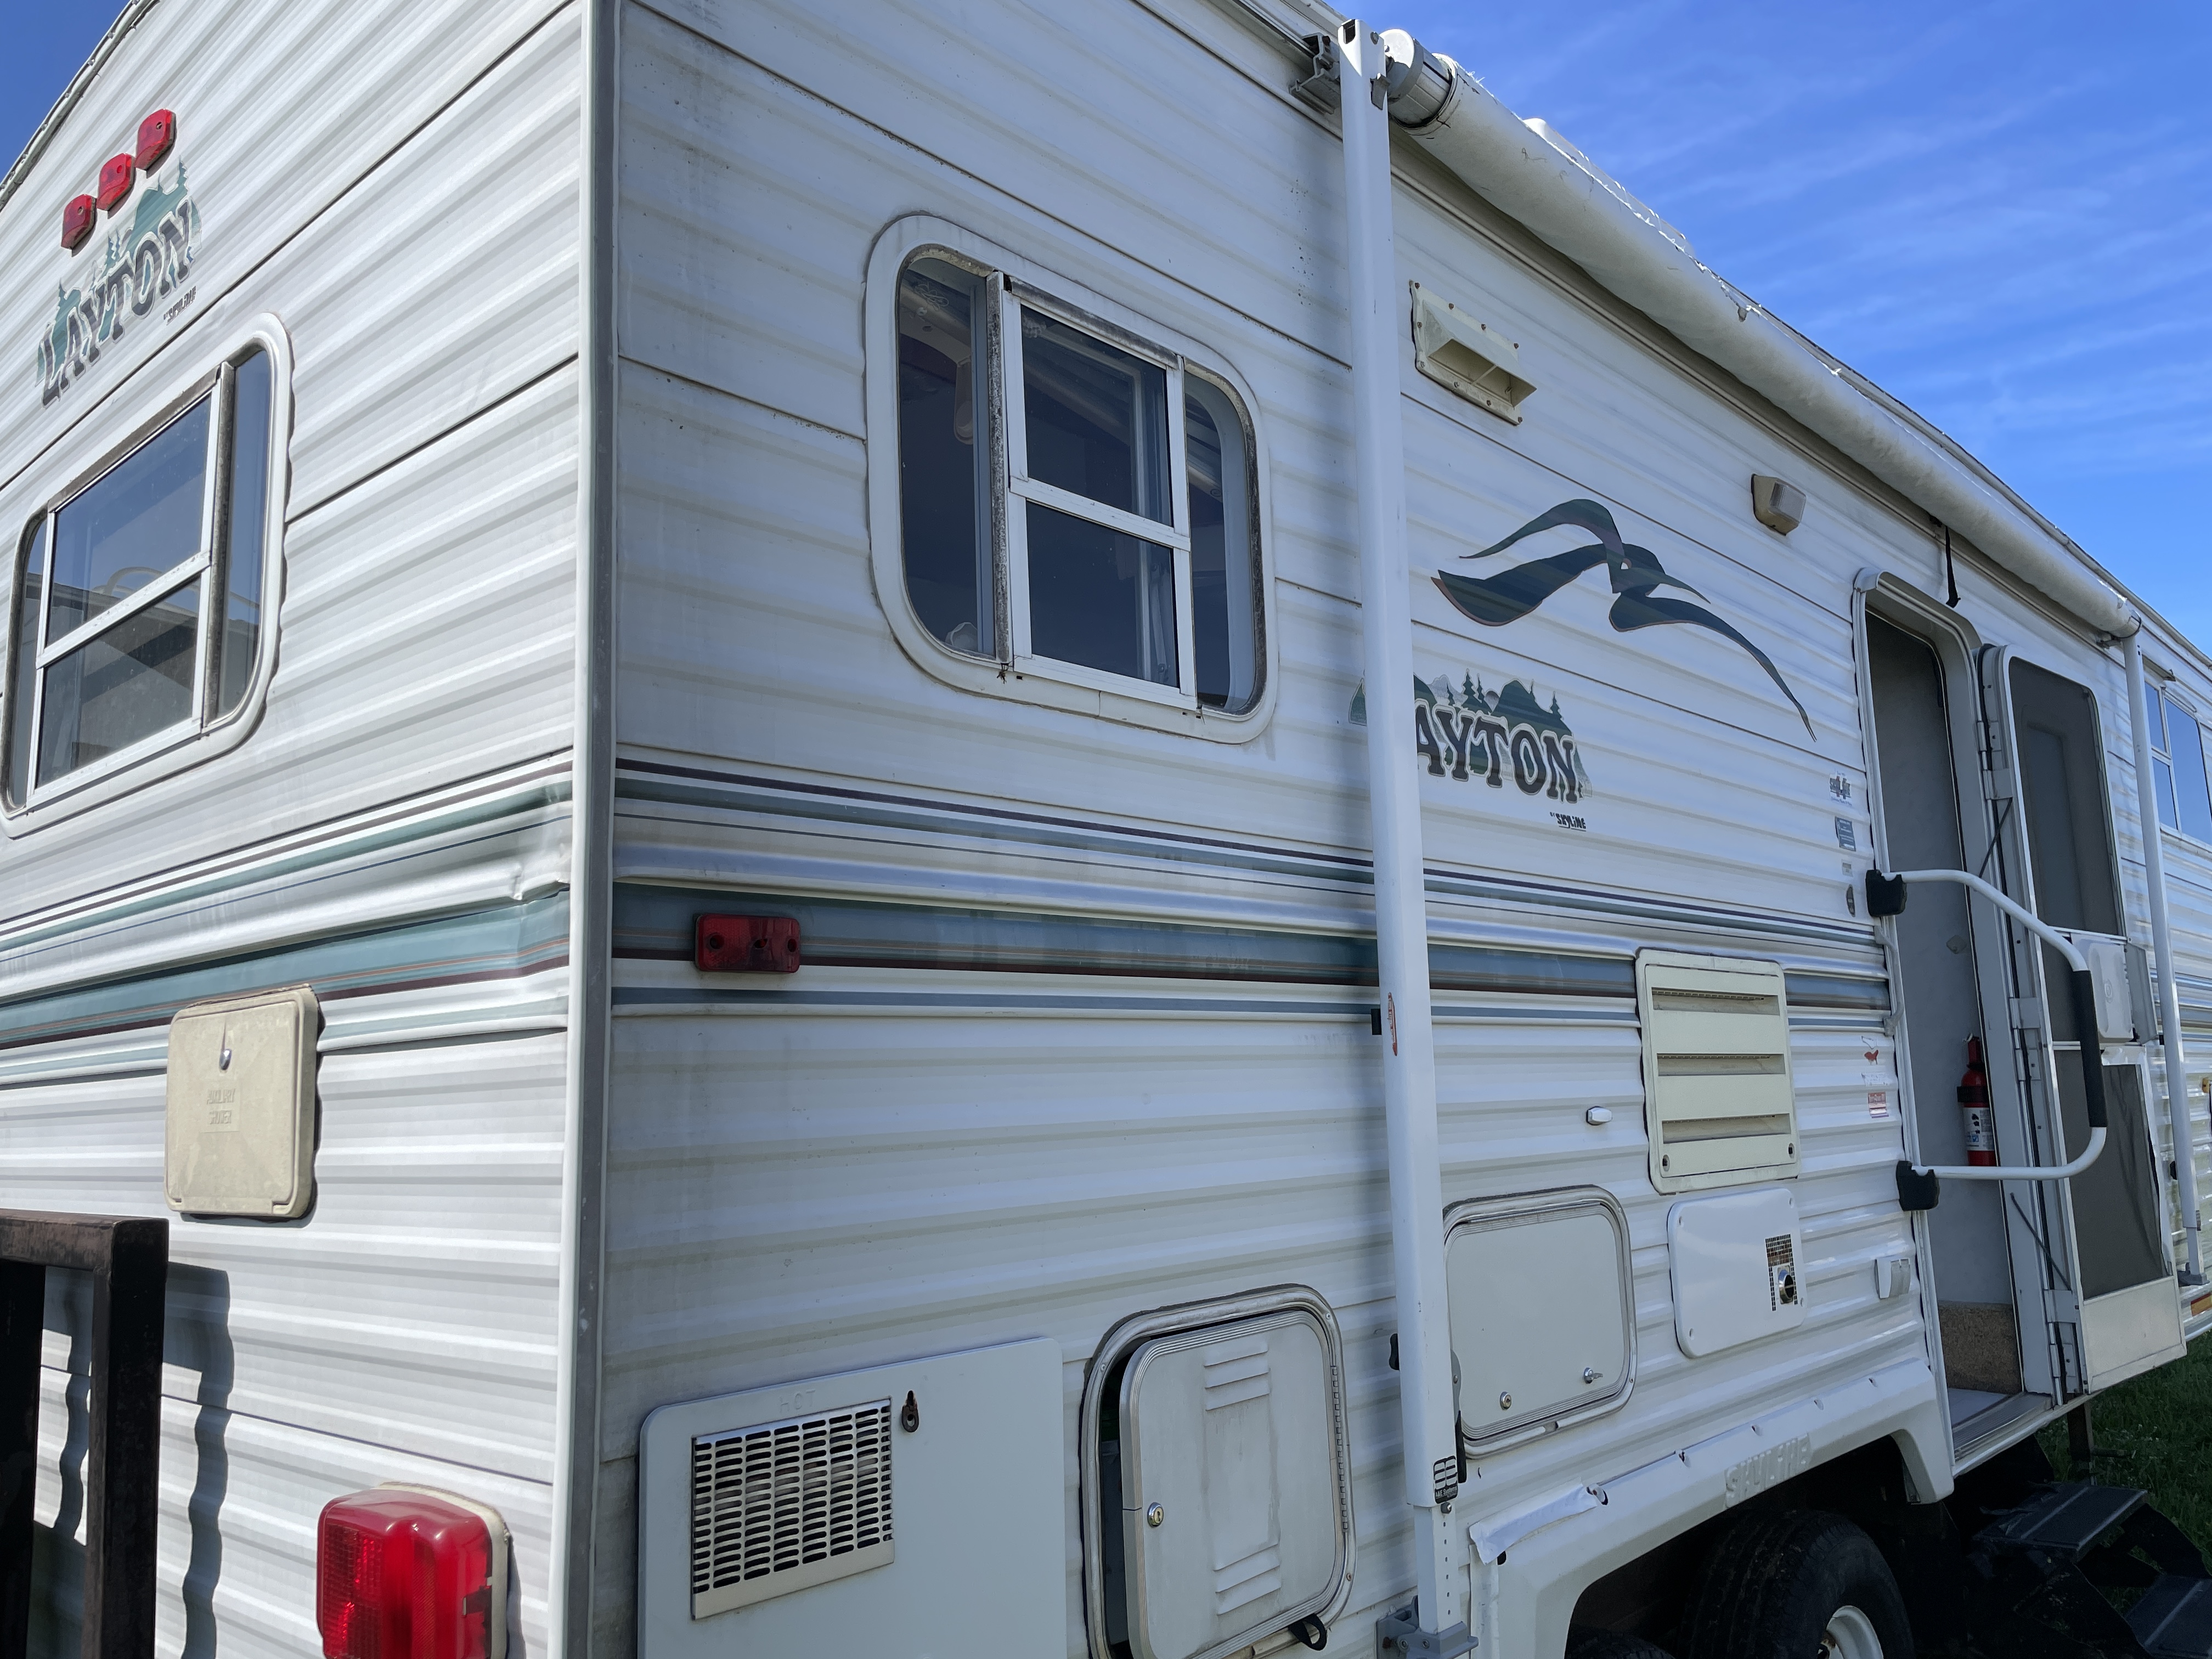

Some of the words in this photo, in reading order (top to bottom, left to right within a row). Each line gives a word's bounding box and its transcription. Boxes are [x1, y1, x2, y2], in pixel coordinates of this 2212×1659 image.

[41, 198, 193, 409] LAYTON
[1415, 704, 1578, 804] AYTON
[778, 1388, 816, 1413] HOT
